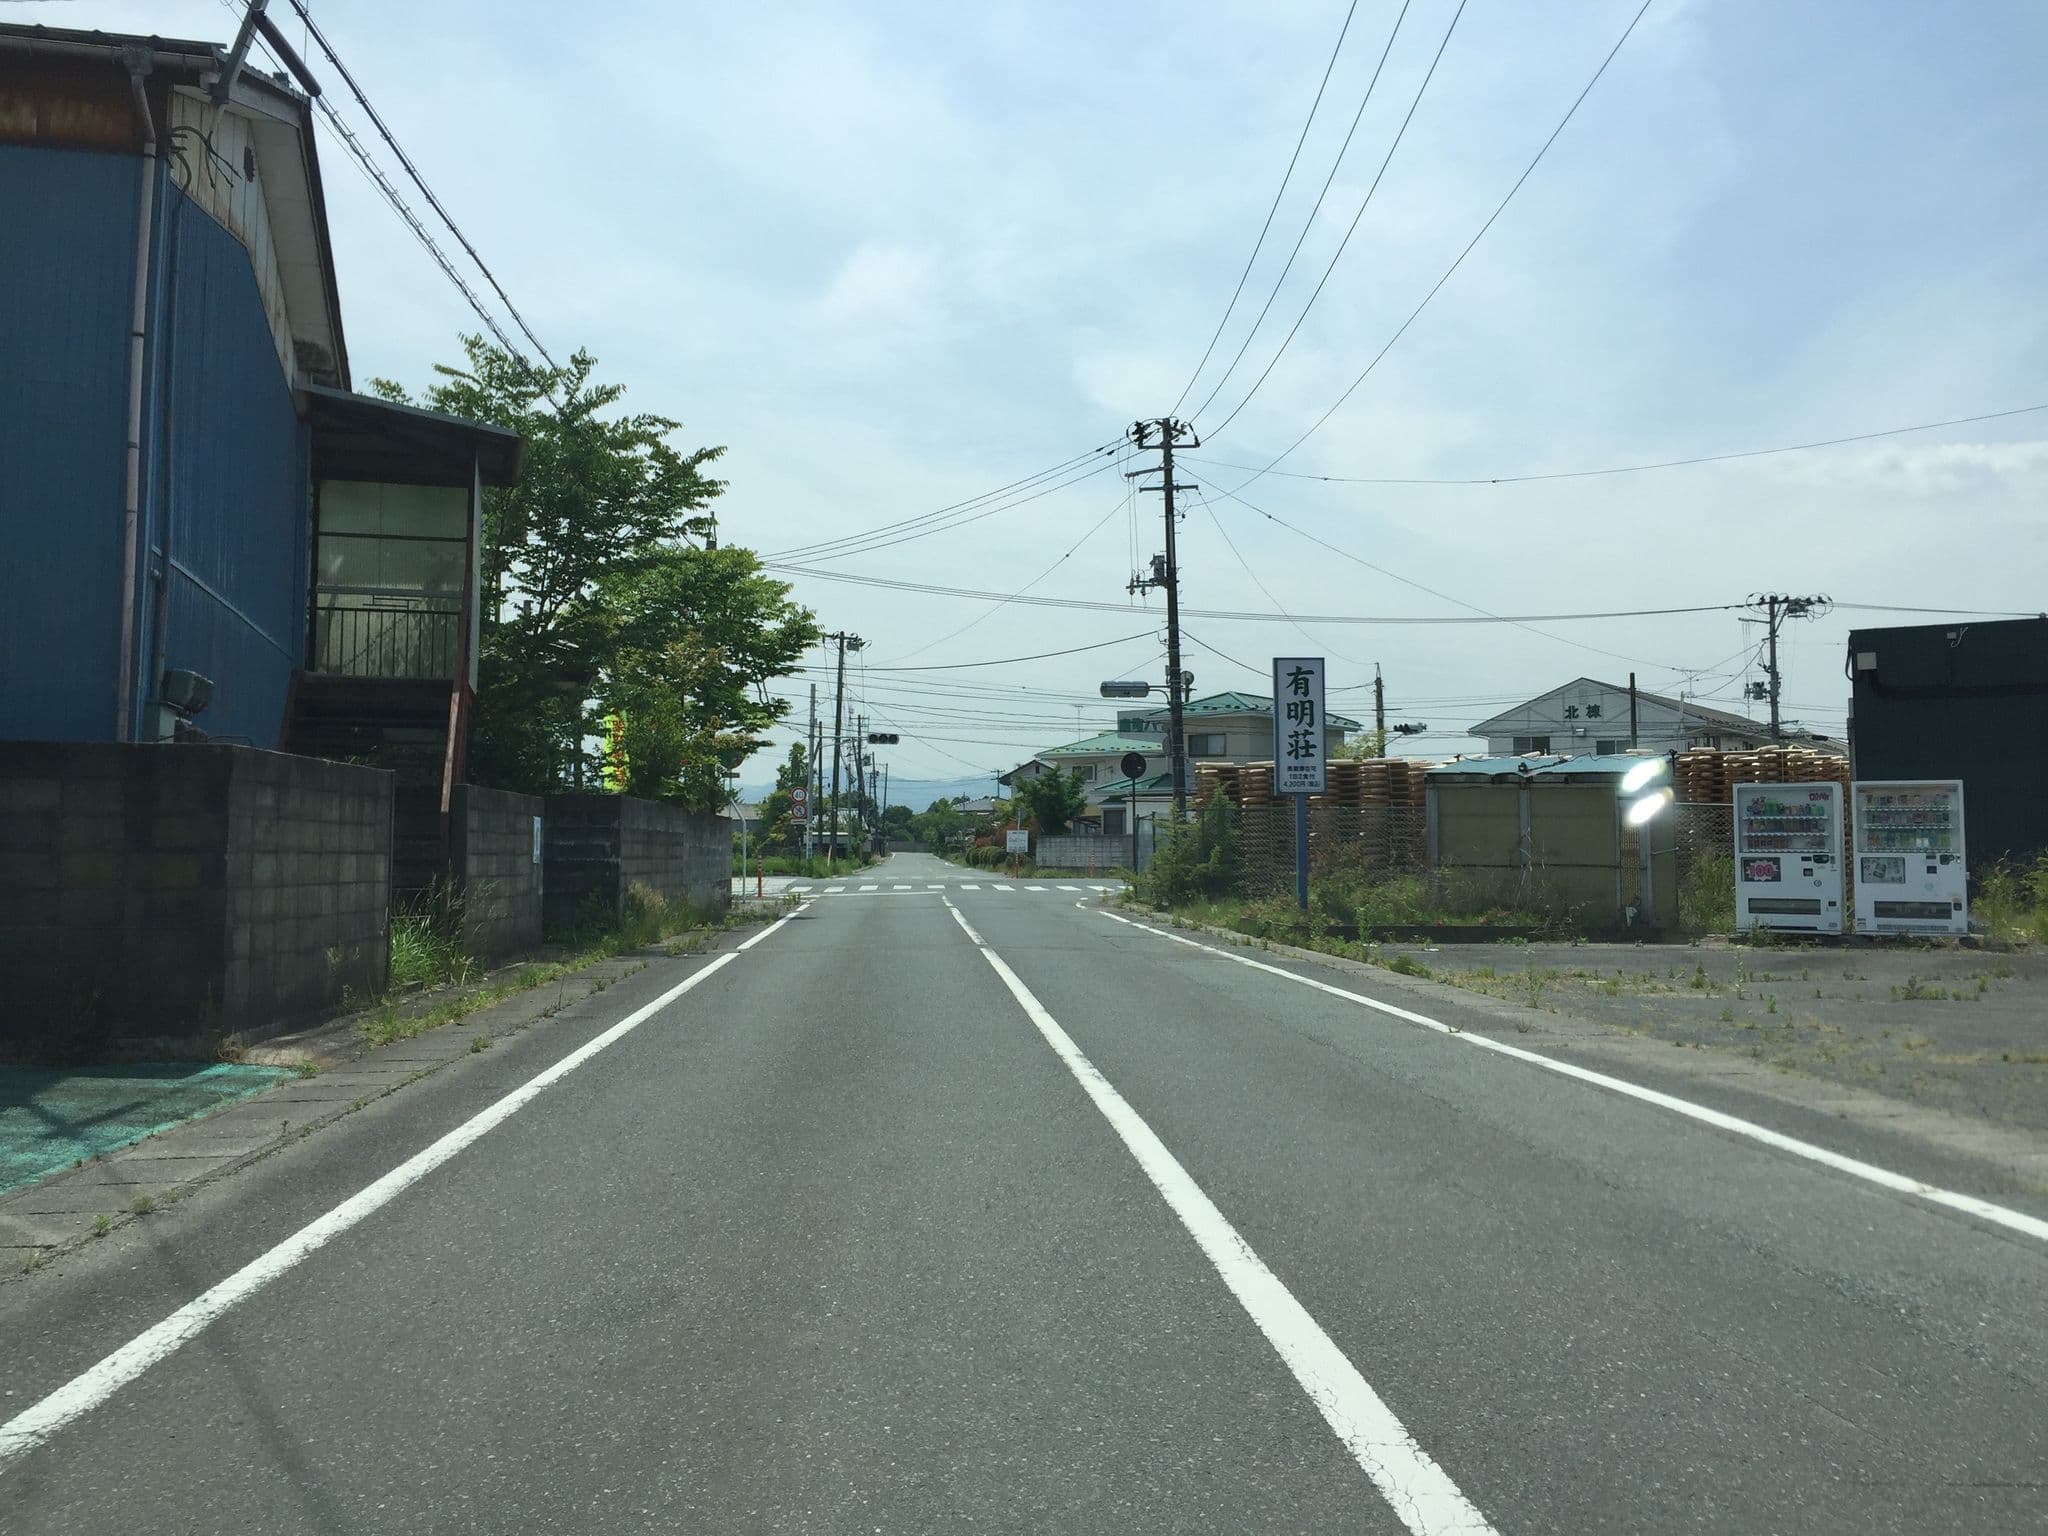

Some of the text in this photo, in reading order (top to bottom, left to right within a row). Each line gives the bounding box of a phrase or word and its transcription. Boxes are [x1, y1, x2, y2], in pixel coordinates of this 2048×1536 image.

[1286, 665, 1317, 760] 有明荘
[1564, 704, 1602, 719] 北棟
[794, 790, 804, 799] 40
